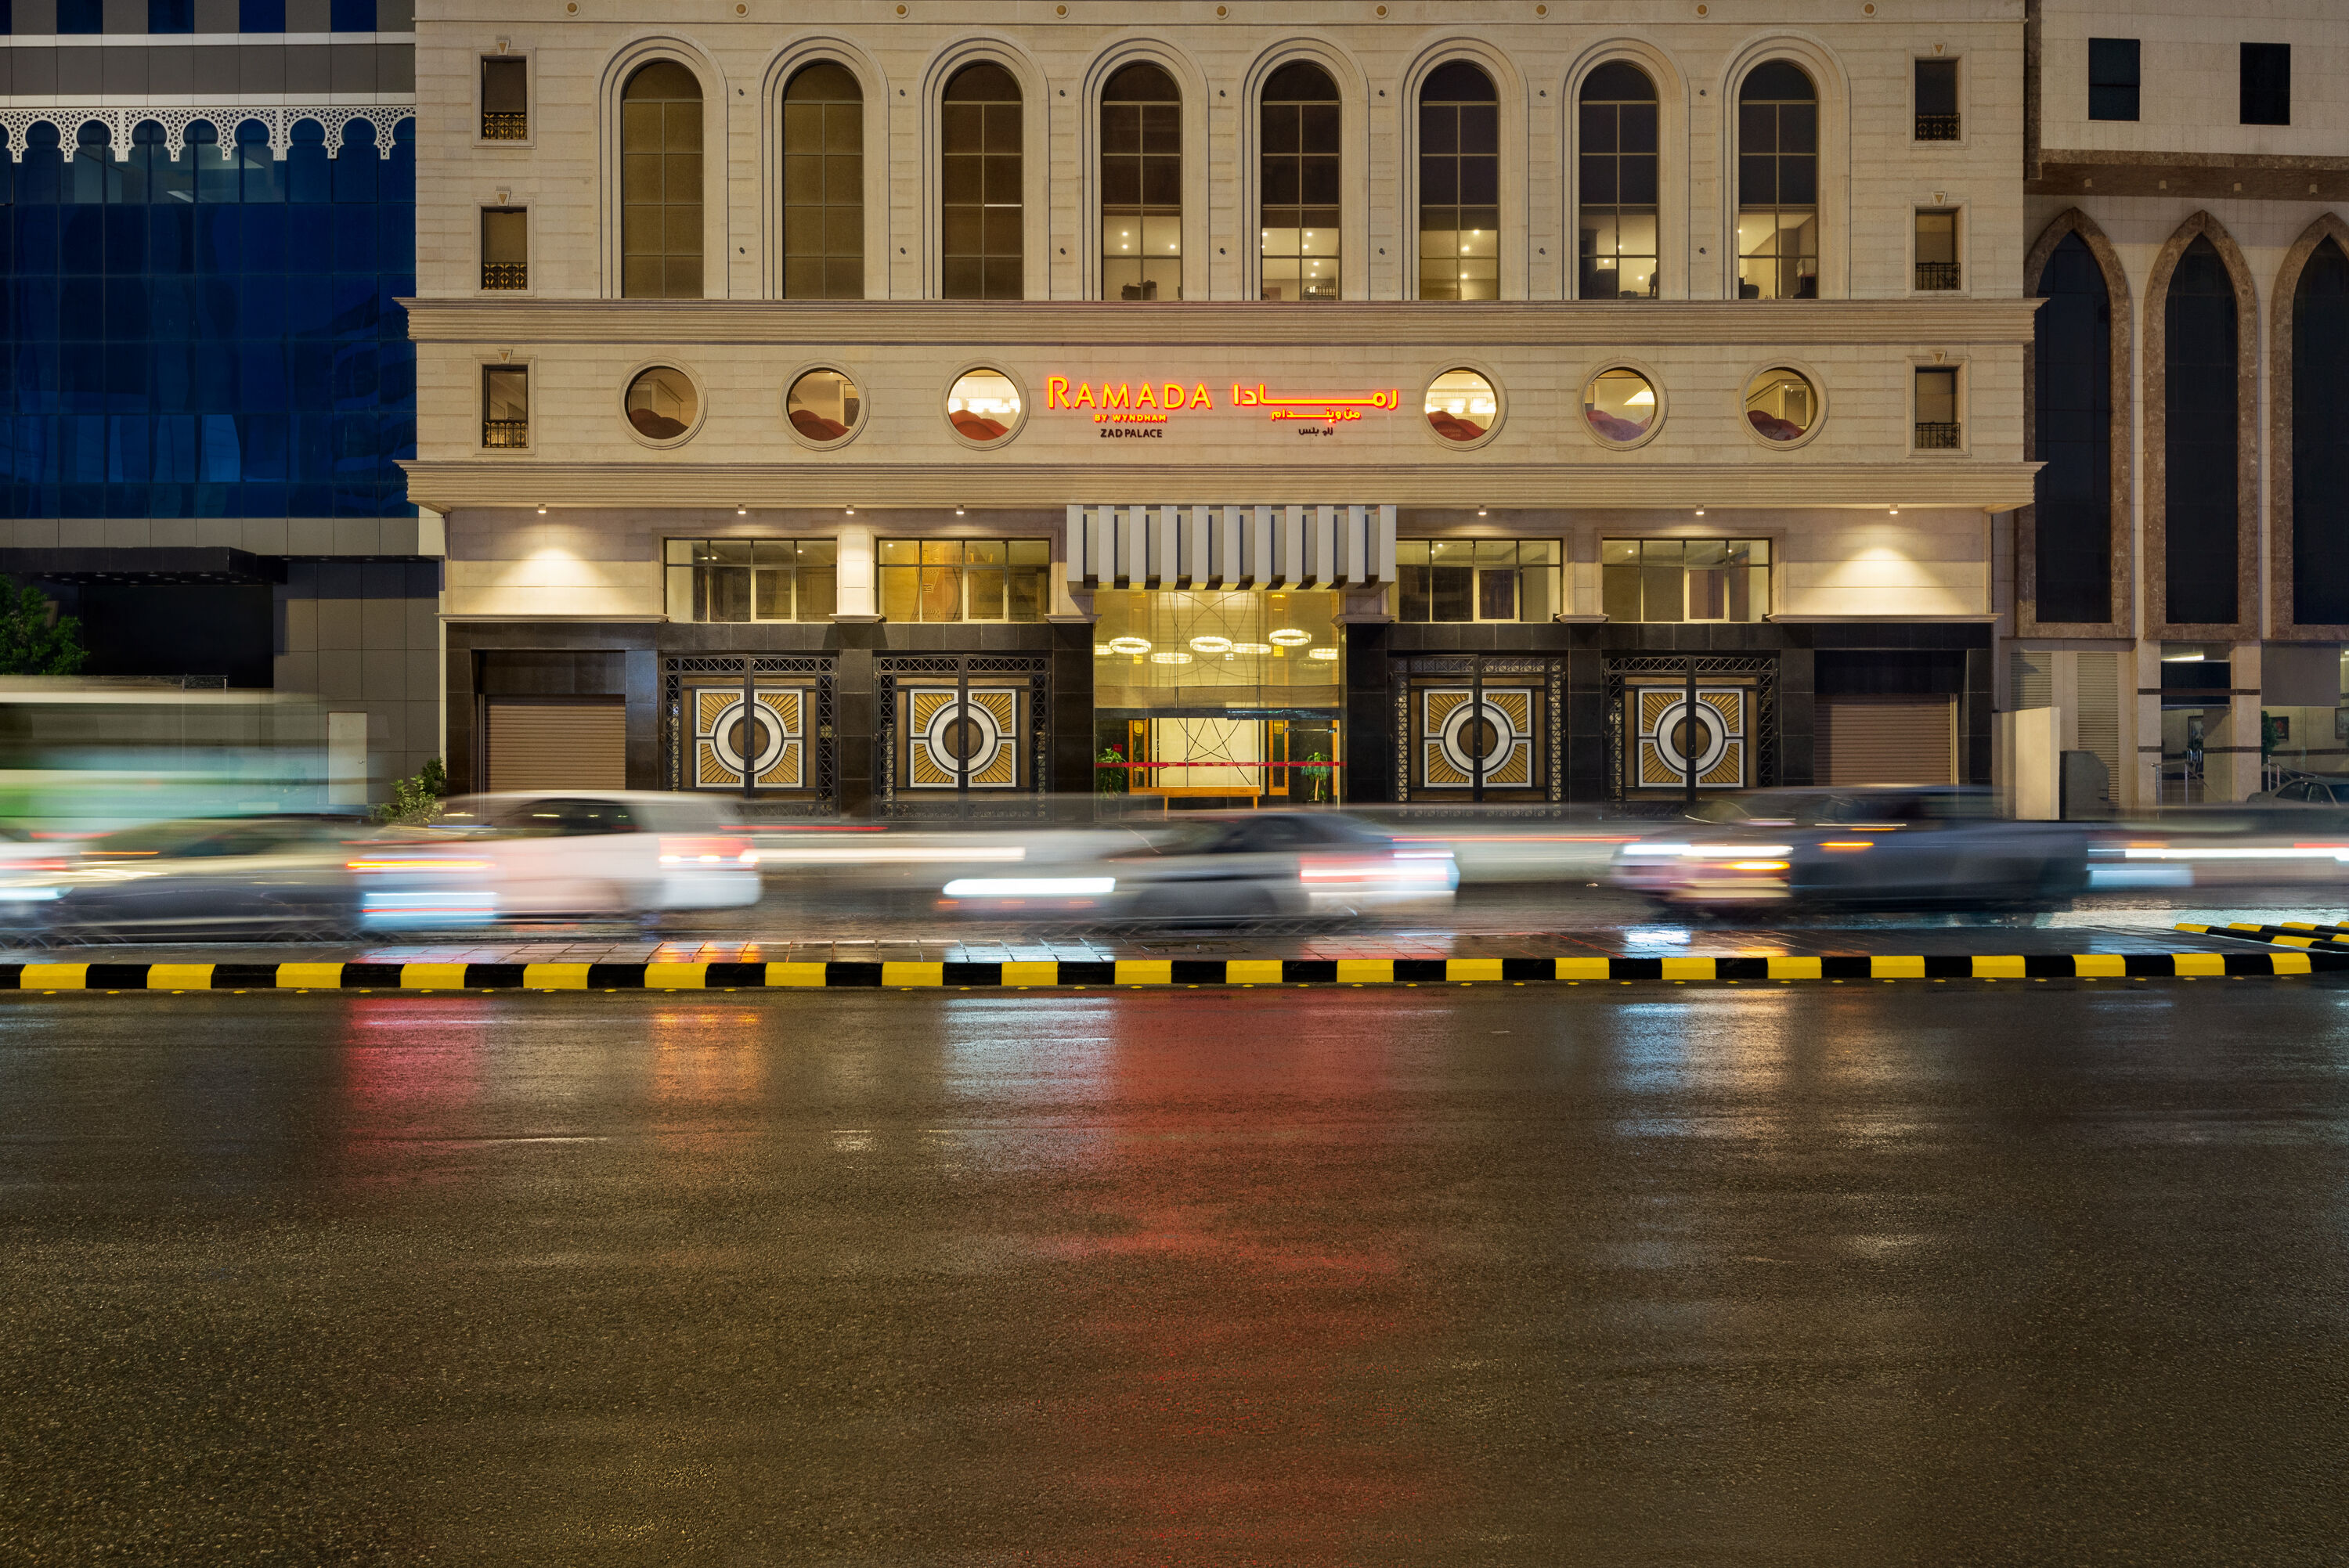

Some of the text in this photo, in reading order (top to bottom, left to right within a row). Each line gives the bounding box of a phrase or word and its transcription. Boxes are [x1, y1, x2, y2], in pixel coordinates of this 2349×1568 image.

[1048, 376, 1213, 409] RAMADA
[1094, 413, 1168, 423] BY WYNDHAM
[1343, 407, 1361, 420] من
[1100, 428, 1163, 438] ZAD PALACE
